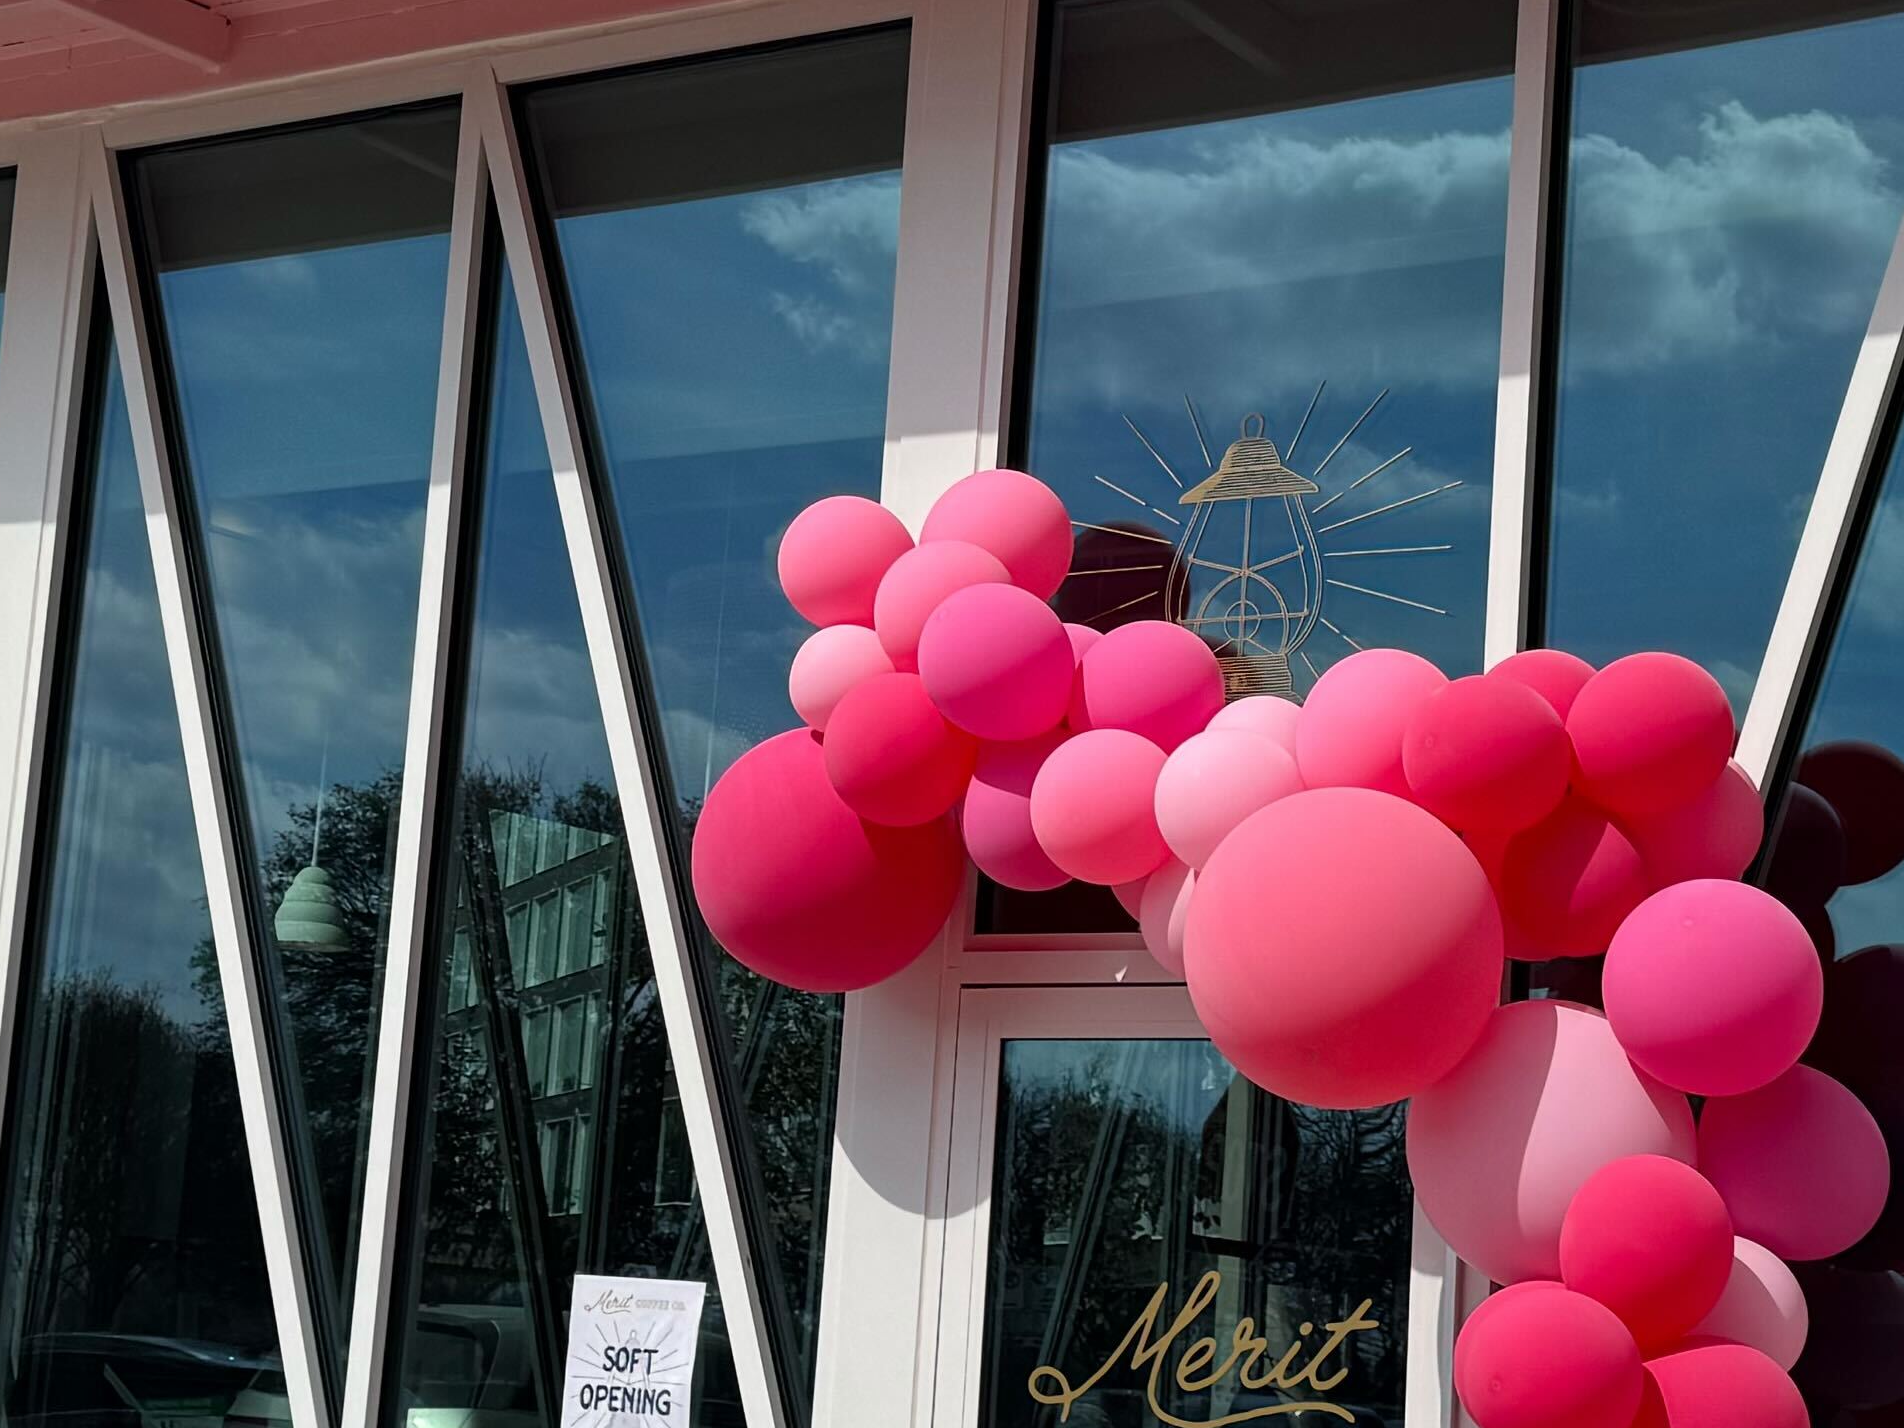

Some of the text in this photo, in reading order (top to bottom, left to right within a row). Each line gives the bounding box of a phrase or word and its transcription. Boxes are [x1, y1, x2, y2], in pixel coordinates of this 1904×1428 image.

[584, 1289, 633, 1314] Merit
[602, 1345, 658, 1375] SOFT
[579, 1383, 671, 1416] OPENING
